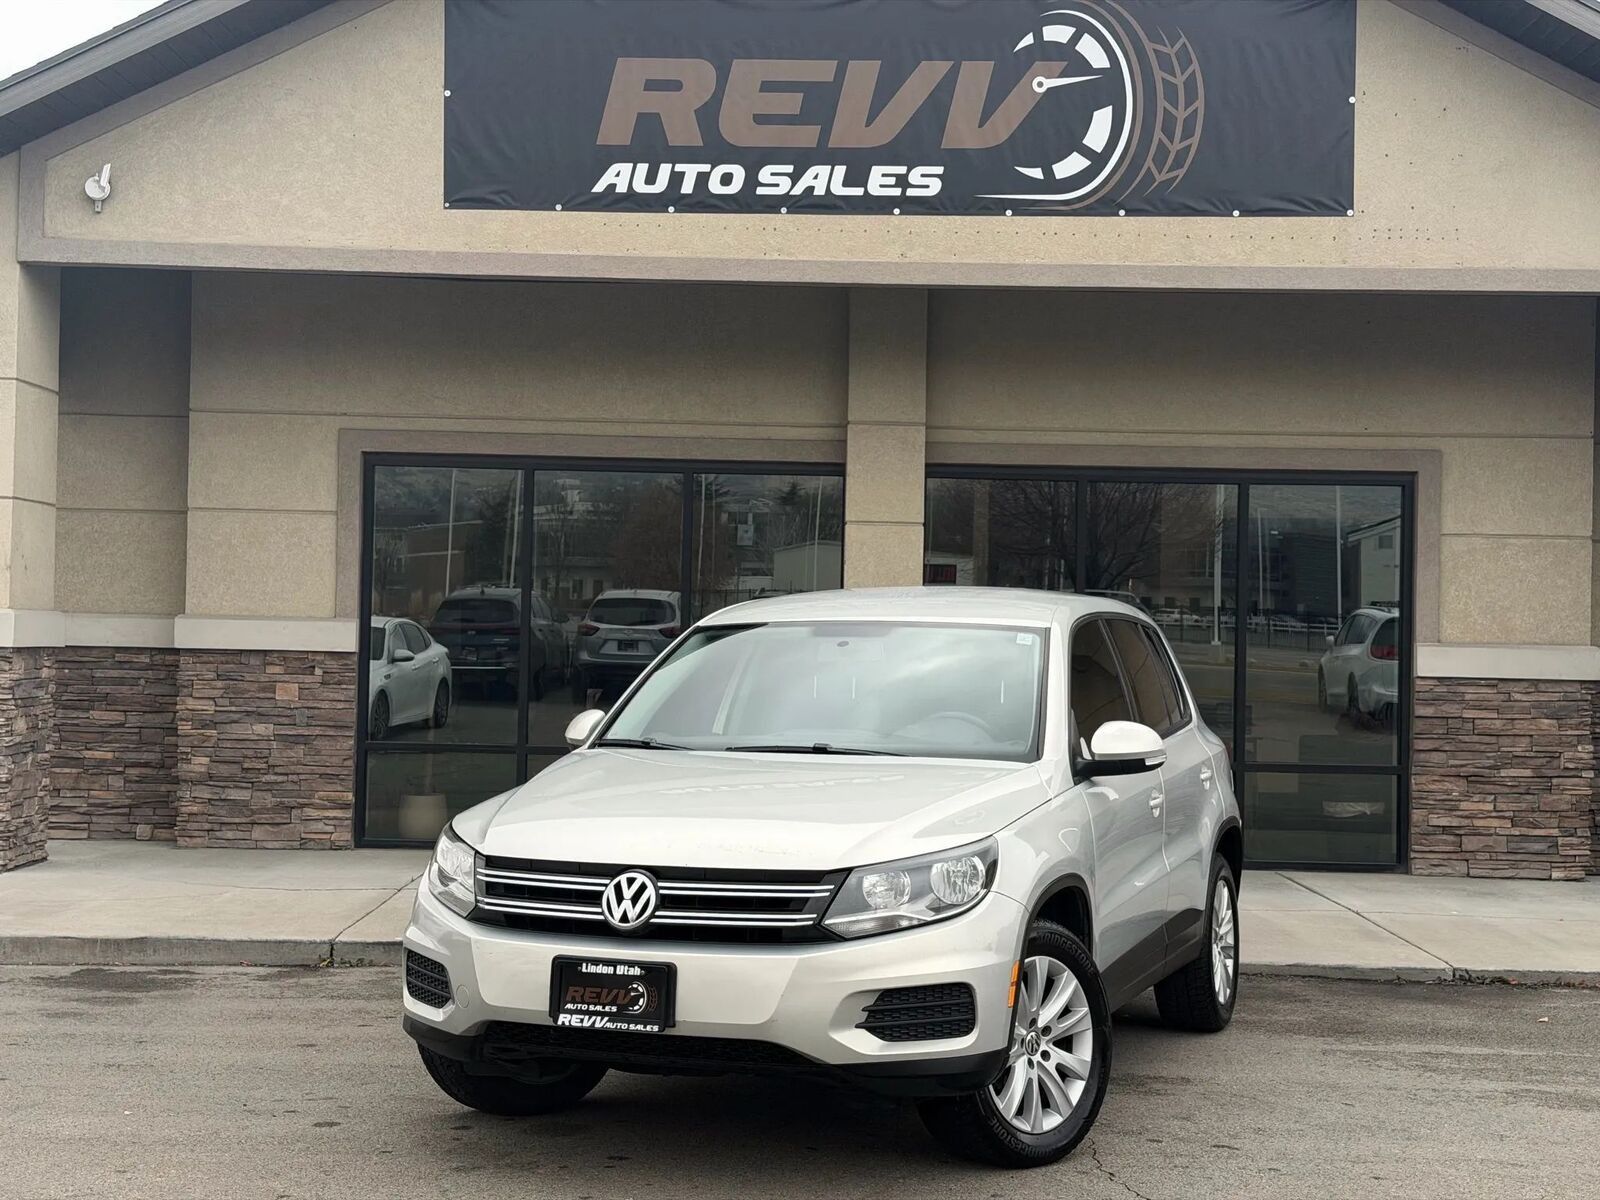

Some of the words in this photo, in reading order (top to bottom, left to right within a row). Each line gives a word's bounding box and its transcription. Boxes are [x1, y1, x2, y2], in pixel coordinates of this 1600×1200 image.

[595, 57, 1069, 149] REVV
[590, 162, 746, 195] AUTO
[755, 164, 945, 197] SALES
[581, 962, 614, 974] Lindon
[616, 964, 641, 976] Utah
[565, 986, 631, 1005] REVV
[564, 1003, 588, 1011] AUTO
[588, 1004, 618, 1012] SALES
[557, 1013, 609, 1028] REVV
[604, 1022, 628, 1030] AUTO
[628, 1023, 659, 1032] SALES
